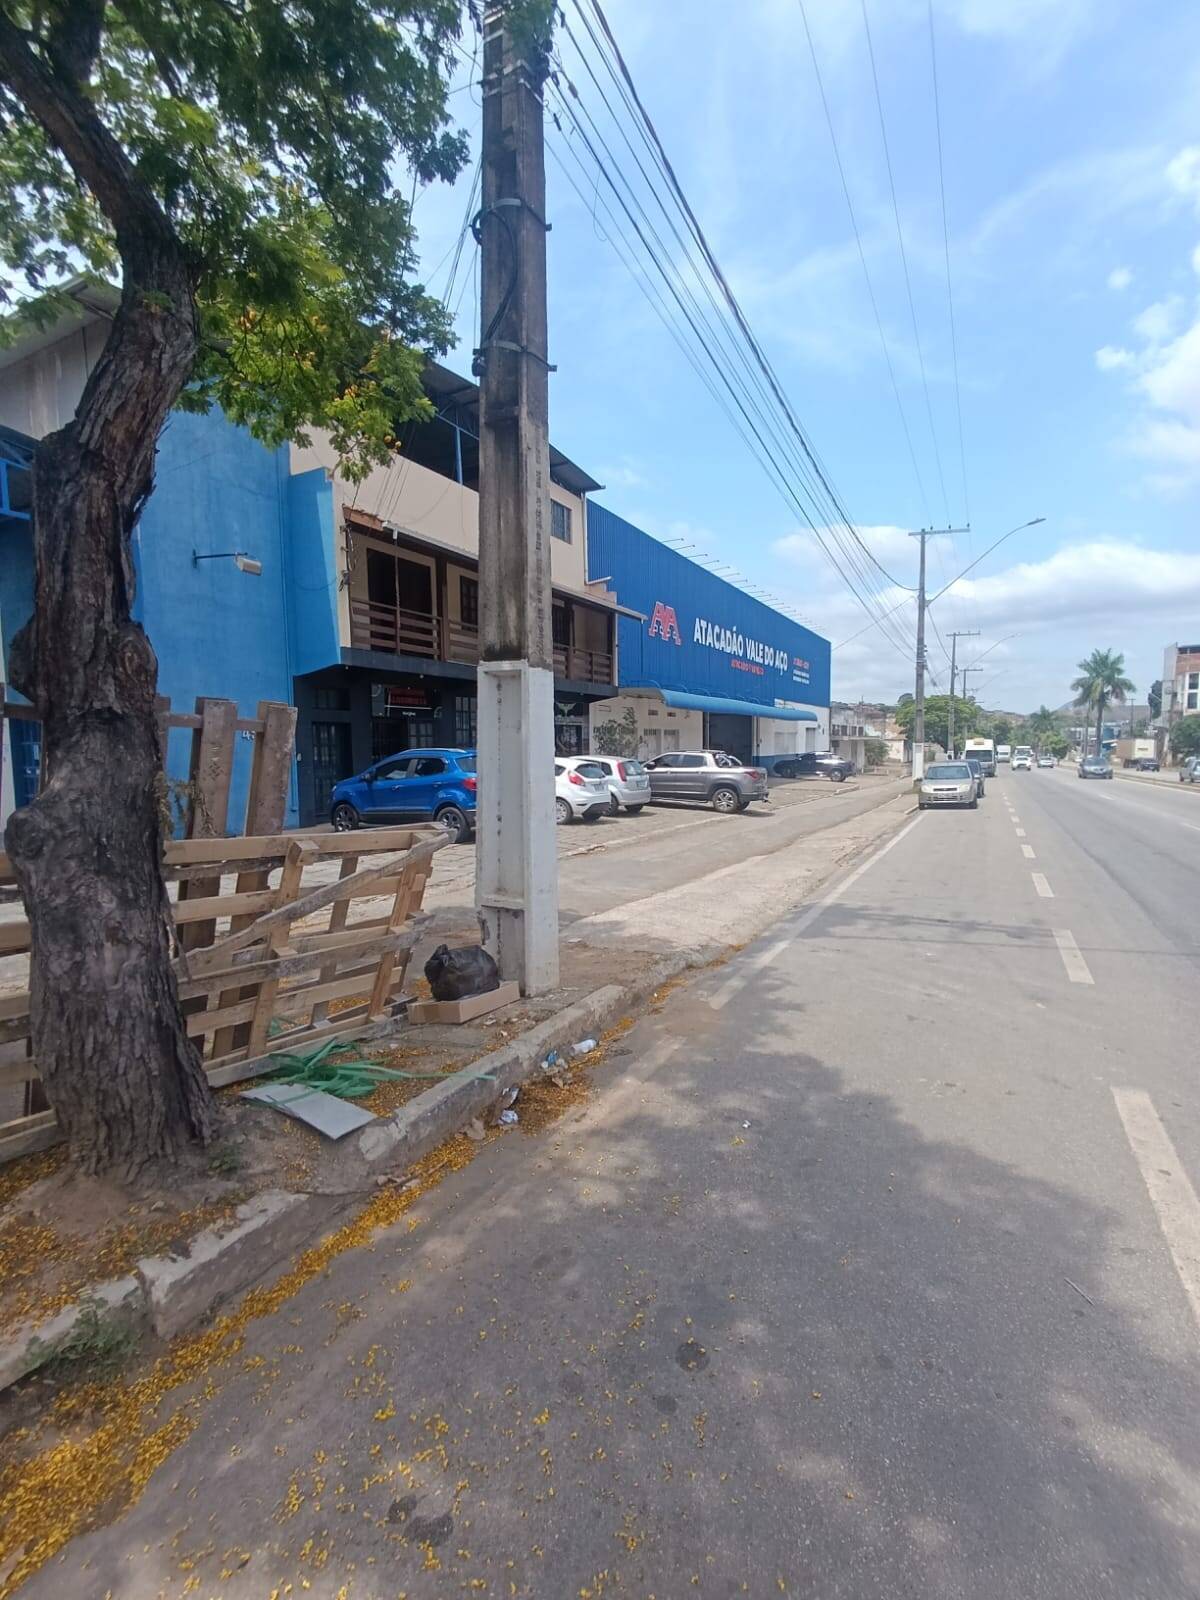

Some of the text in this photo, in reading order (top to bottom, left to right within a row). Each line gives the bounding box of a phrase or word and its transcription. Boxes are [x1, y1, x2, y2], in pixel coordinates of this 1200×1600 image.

[746, 637, 763, 663] VALE
[764, 645, 774, 667] DO
[774, 649, 788, 676] AÇO
